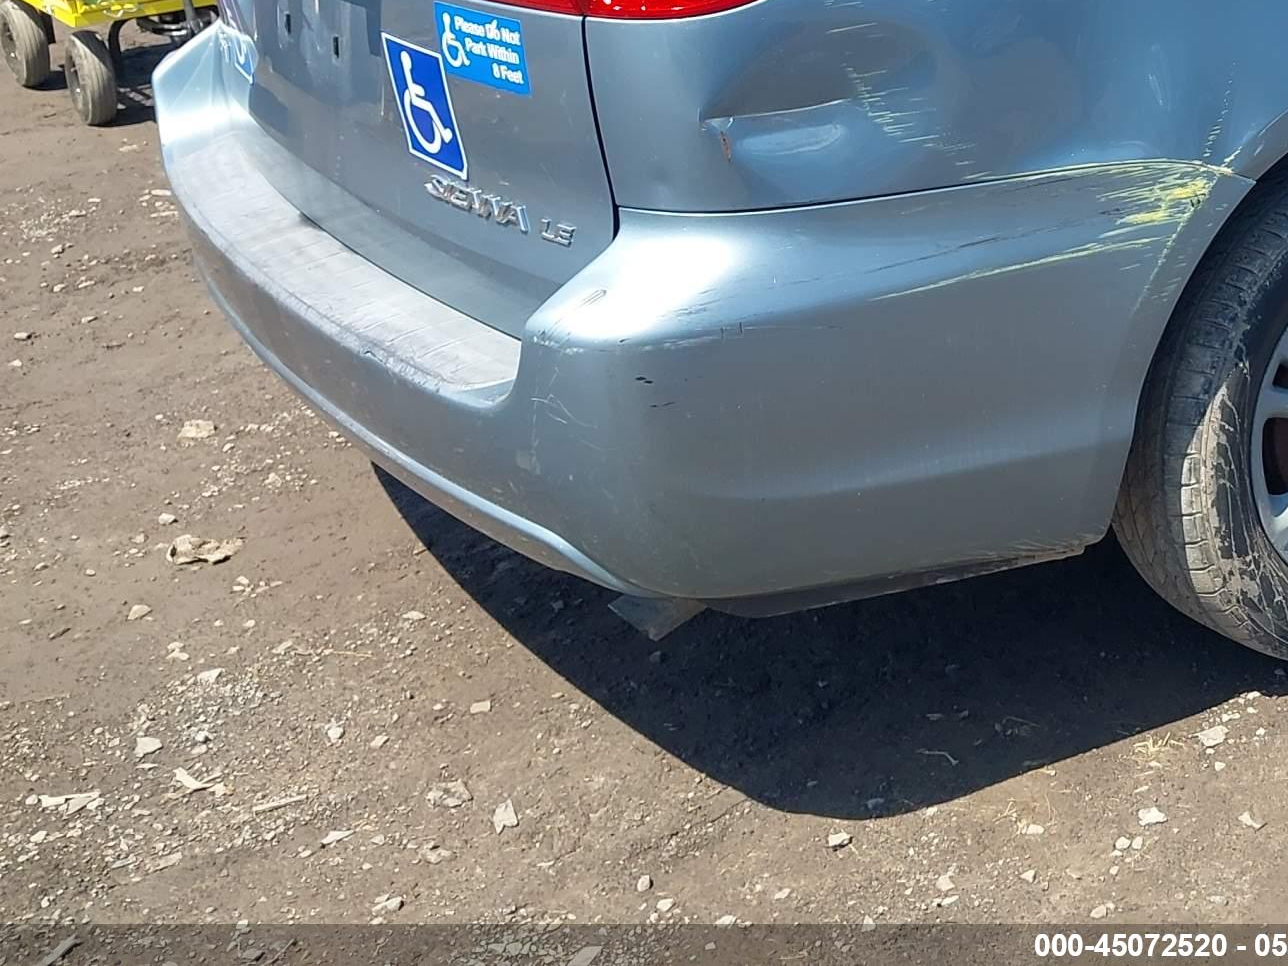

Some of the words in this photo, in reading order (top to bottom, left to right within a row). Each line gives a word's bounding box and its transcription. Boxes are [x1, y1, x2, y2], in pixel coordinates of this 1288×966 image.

[453, 15, 485, 37] Please
[484, 20, 501, 41] Do
[500, 27, 521, 46] Not
[464, 37, 487, 56] Park
[487, 42, 520, 65] Within
[500, 65, 524, 84] Feet
[424, 174, 530, 233] SIENNA
[541, 218, 577, 248] LE
